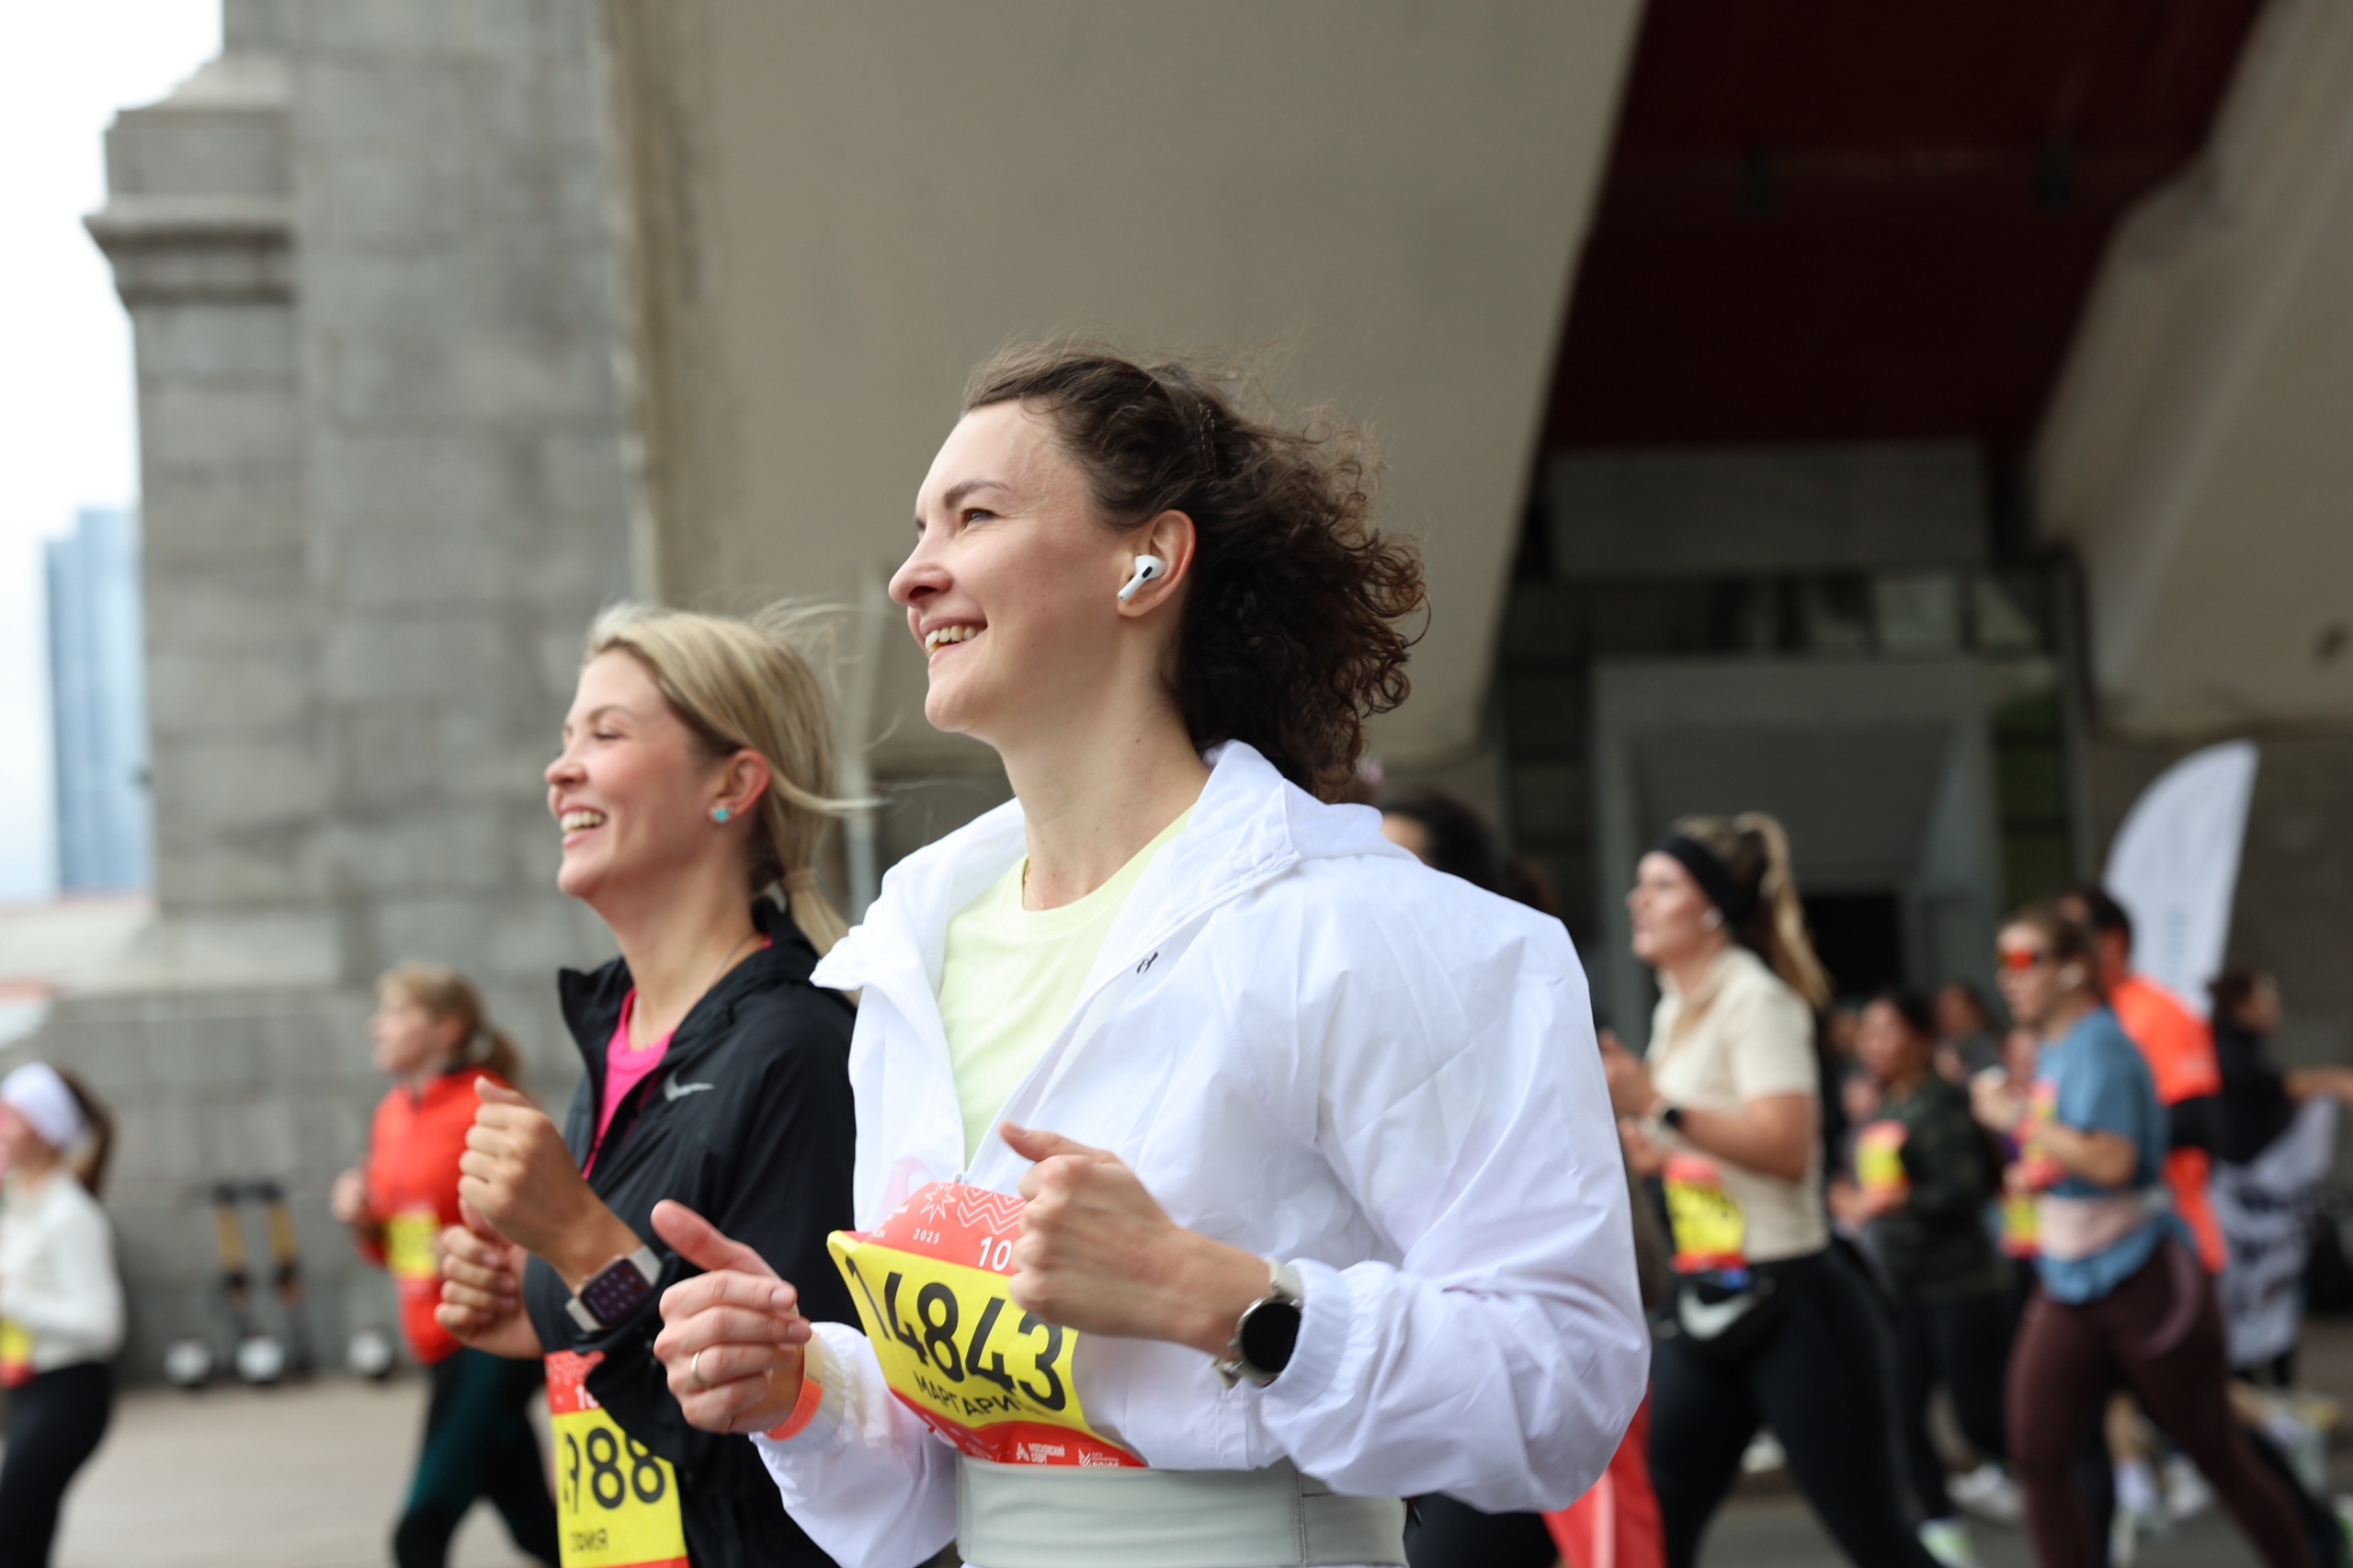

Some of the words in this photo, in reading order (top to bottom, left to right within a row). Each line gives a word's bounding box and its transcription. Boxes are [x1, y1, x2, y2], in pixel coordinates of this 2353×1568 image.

[913, 1228, 941, 1244] 2025
[978, 1236, 1013, 1271] 10
[845, 1255, 1066, 1412] 14843
[913, 1369, 1048, 1418] МАРГАРИ
